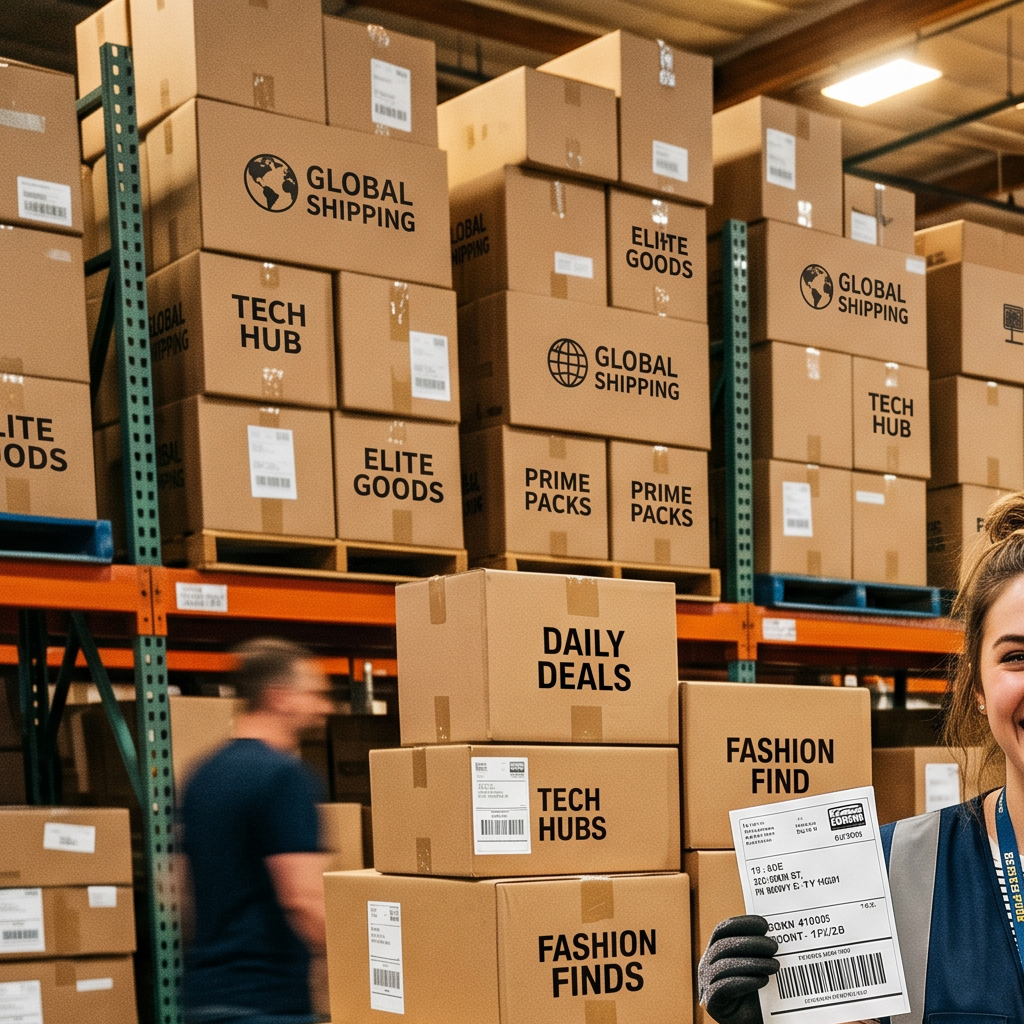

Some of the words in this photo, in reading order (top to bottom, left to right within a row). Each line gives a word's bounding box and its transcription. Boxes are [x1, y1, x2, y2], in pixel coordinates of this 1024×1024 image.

[306, 165, 414, 207] GLOBAL
[306, 194, 416, 233] SHIPPING
[449, 212, 487, 245] LOBAL
[450, 235, 491, 266] HIPPING
[625, 248, 693, 279] GOODS
[838, 272, 906, 304] GLOBAL
[231, 293, 306, 328] TECH
[838, 295, 909, 326] SHIPPING
[240, 323, 302, 355] HUB
[595, 345, 678, 379] GLOBAL
[594, 371, 680, 401] SHIPPING
[868, 392, 914, 417] TECH
[872, 415, 912, 439] HUB
[364, 447, 434, 477] ELITE
[353, 473, 445, 504] GOODS
[524, 467, 590, 494] PRIME
[630, 480, 692, 505] PRIME
[524, 491, 592, 517] PACKS
[630, 503, 694, 527] PACKS
[542, 626, 626, 659] DAILY
[537, 661, 632, 693] DEALS
[726, 737, 835, 765] FASHION
[750, 768, 811, 795] FIND
[537, 787, 601, 813] TECH
[537, 816, 607, 842] HUBS
[538, 928, 658, 963] FASHION
[551, 961, 645, 998] FINDS
